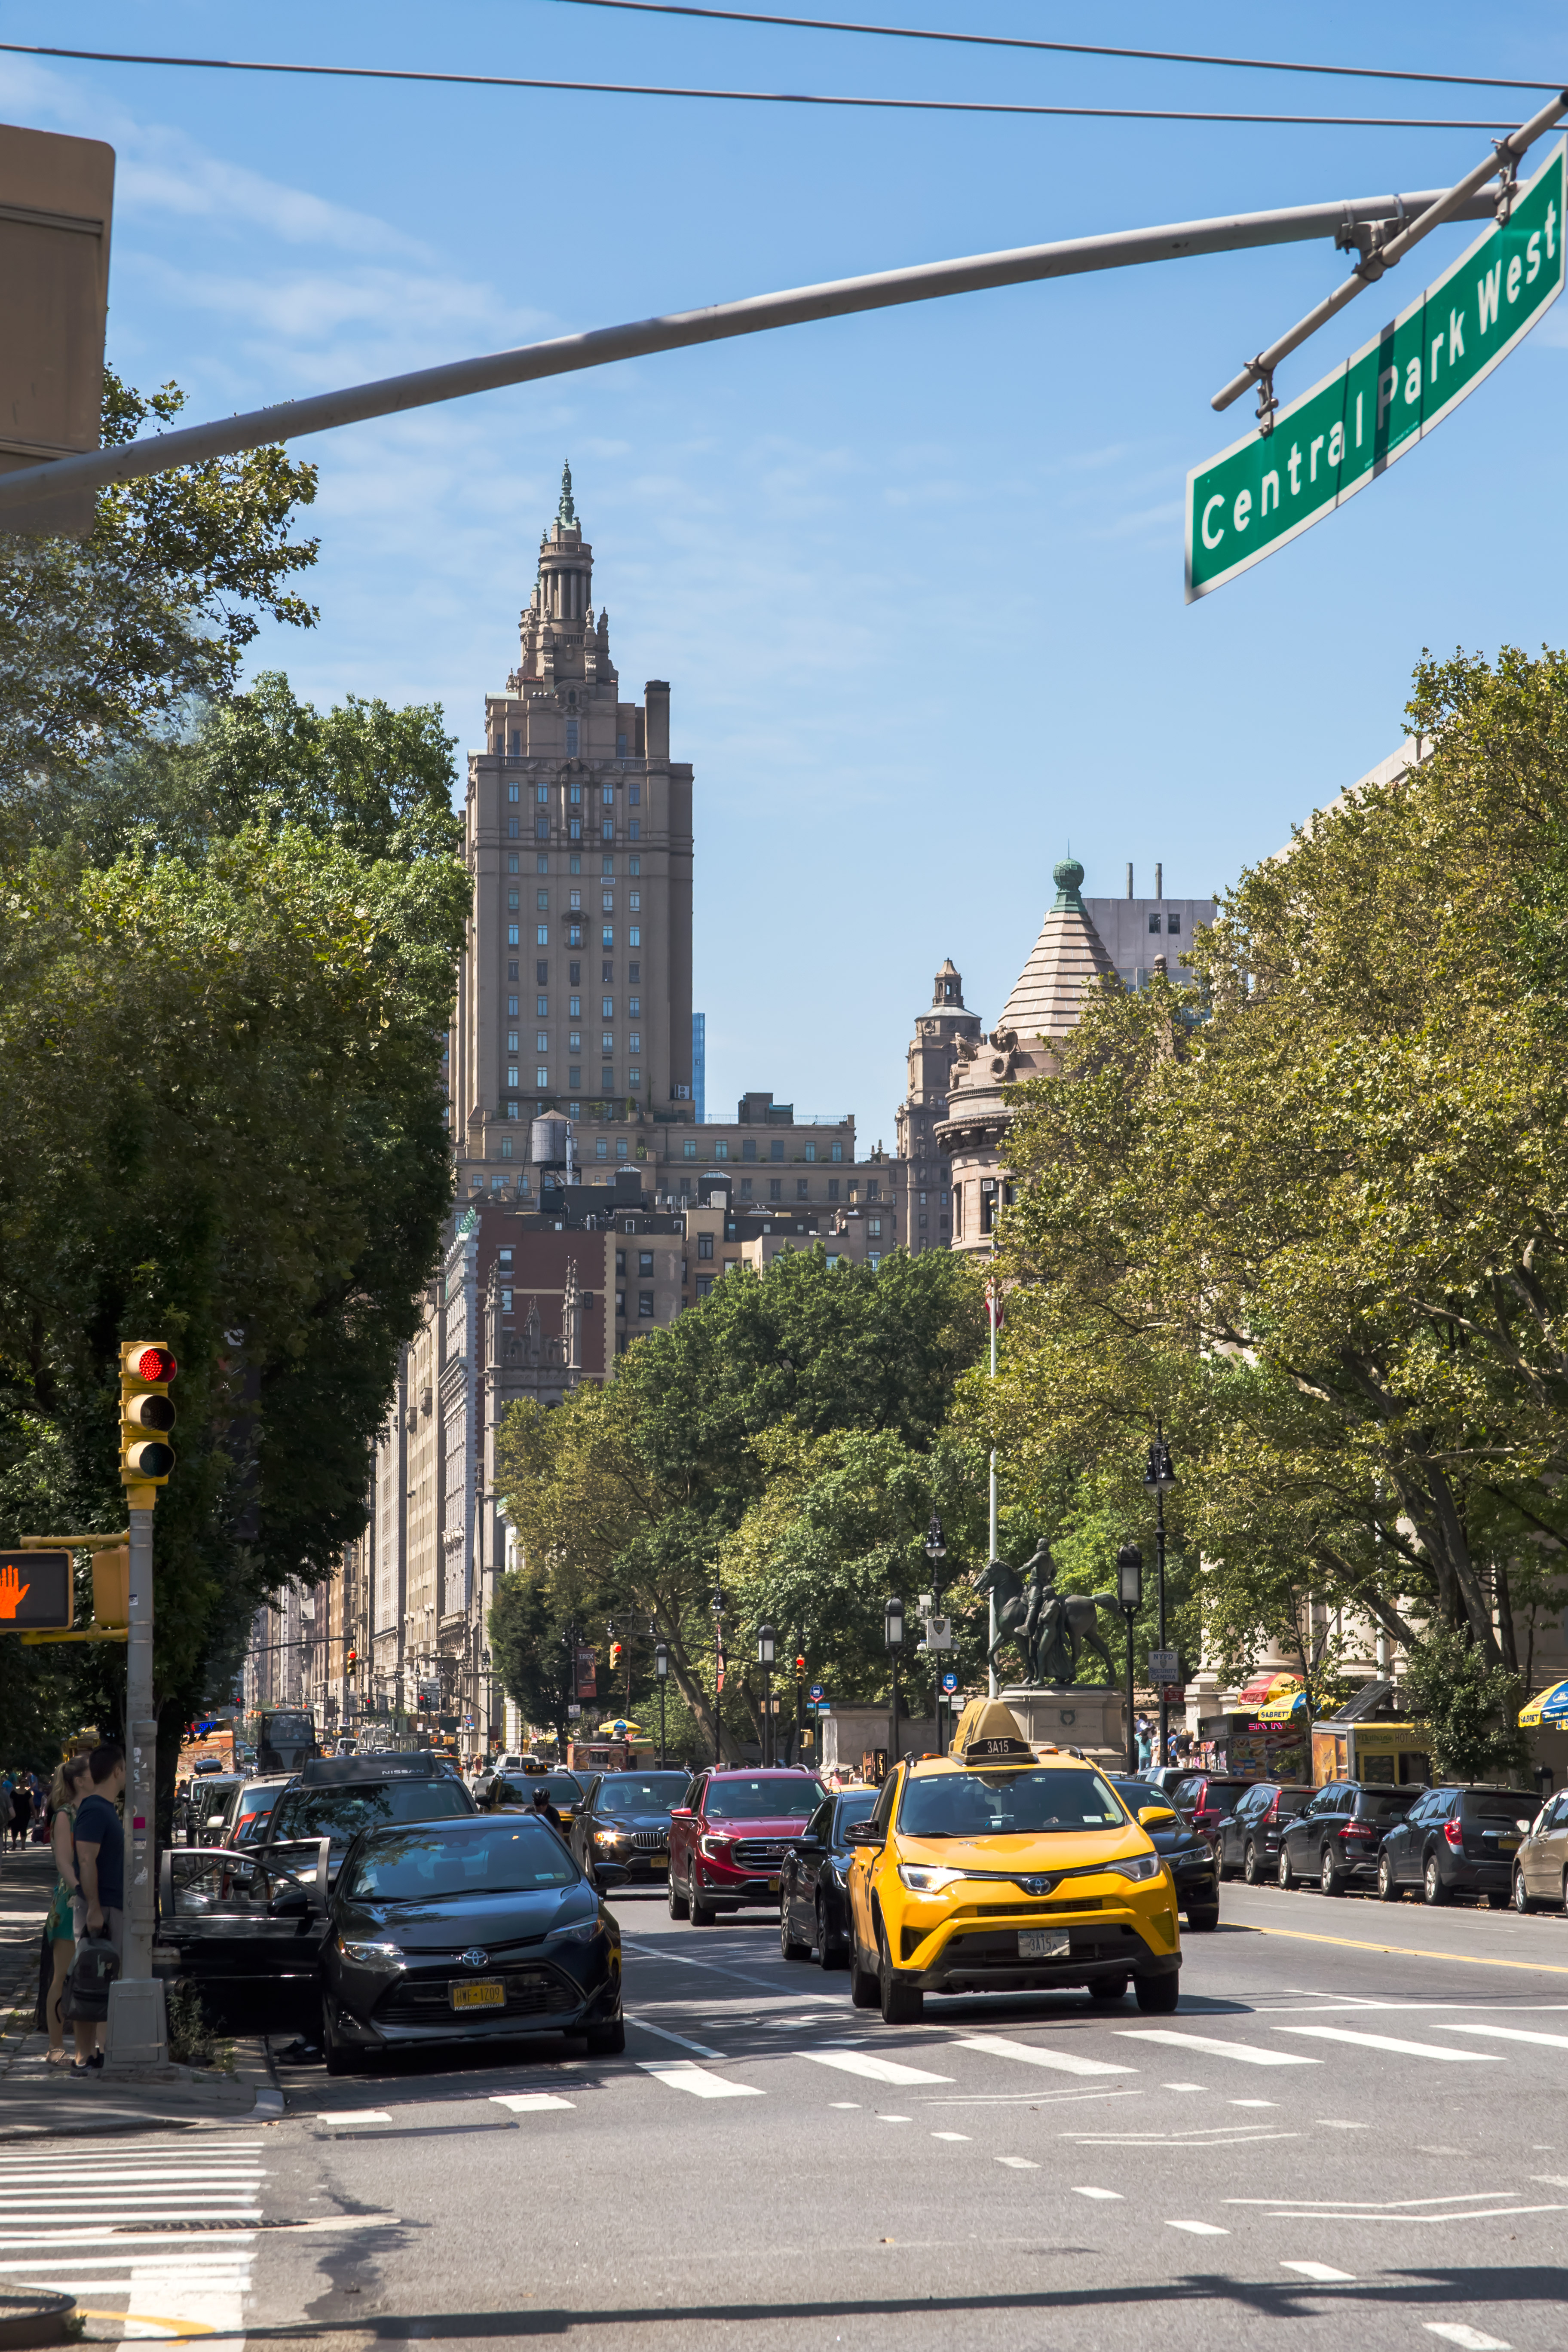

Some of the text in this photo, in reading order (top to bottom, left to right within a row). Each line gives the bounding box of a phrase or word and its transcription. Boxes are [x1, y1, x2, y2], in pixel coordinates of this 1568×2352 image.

[1201, 199, 1557, 550] Central Park West
[1357, 1733, 1393, 1742] Nathan's
[1395, 1733, 1409, 1743] HOT
[987, 1740, 1009, 1753] 3A15
[766, 1846, 794, 1856] GM
